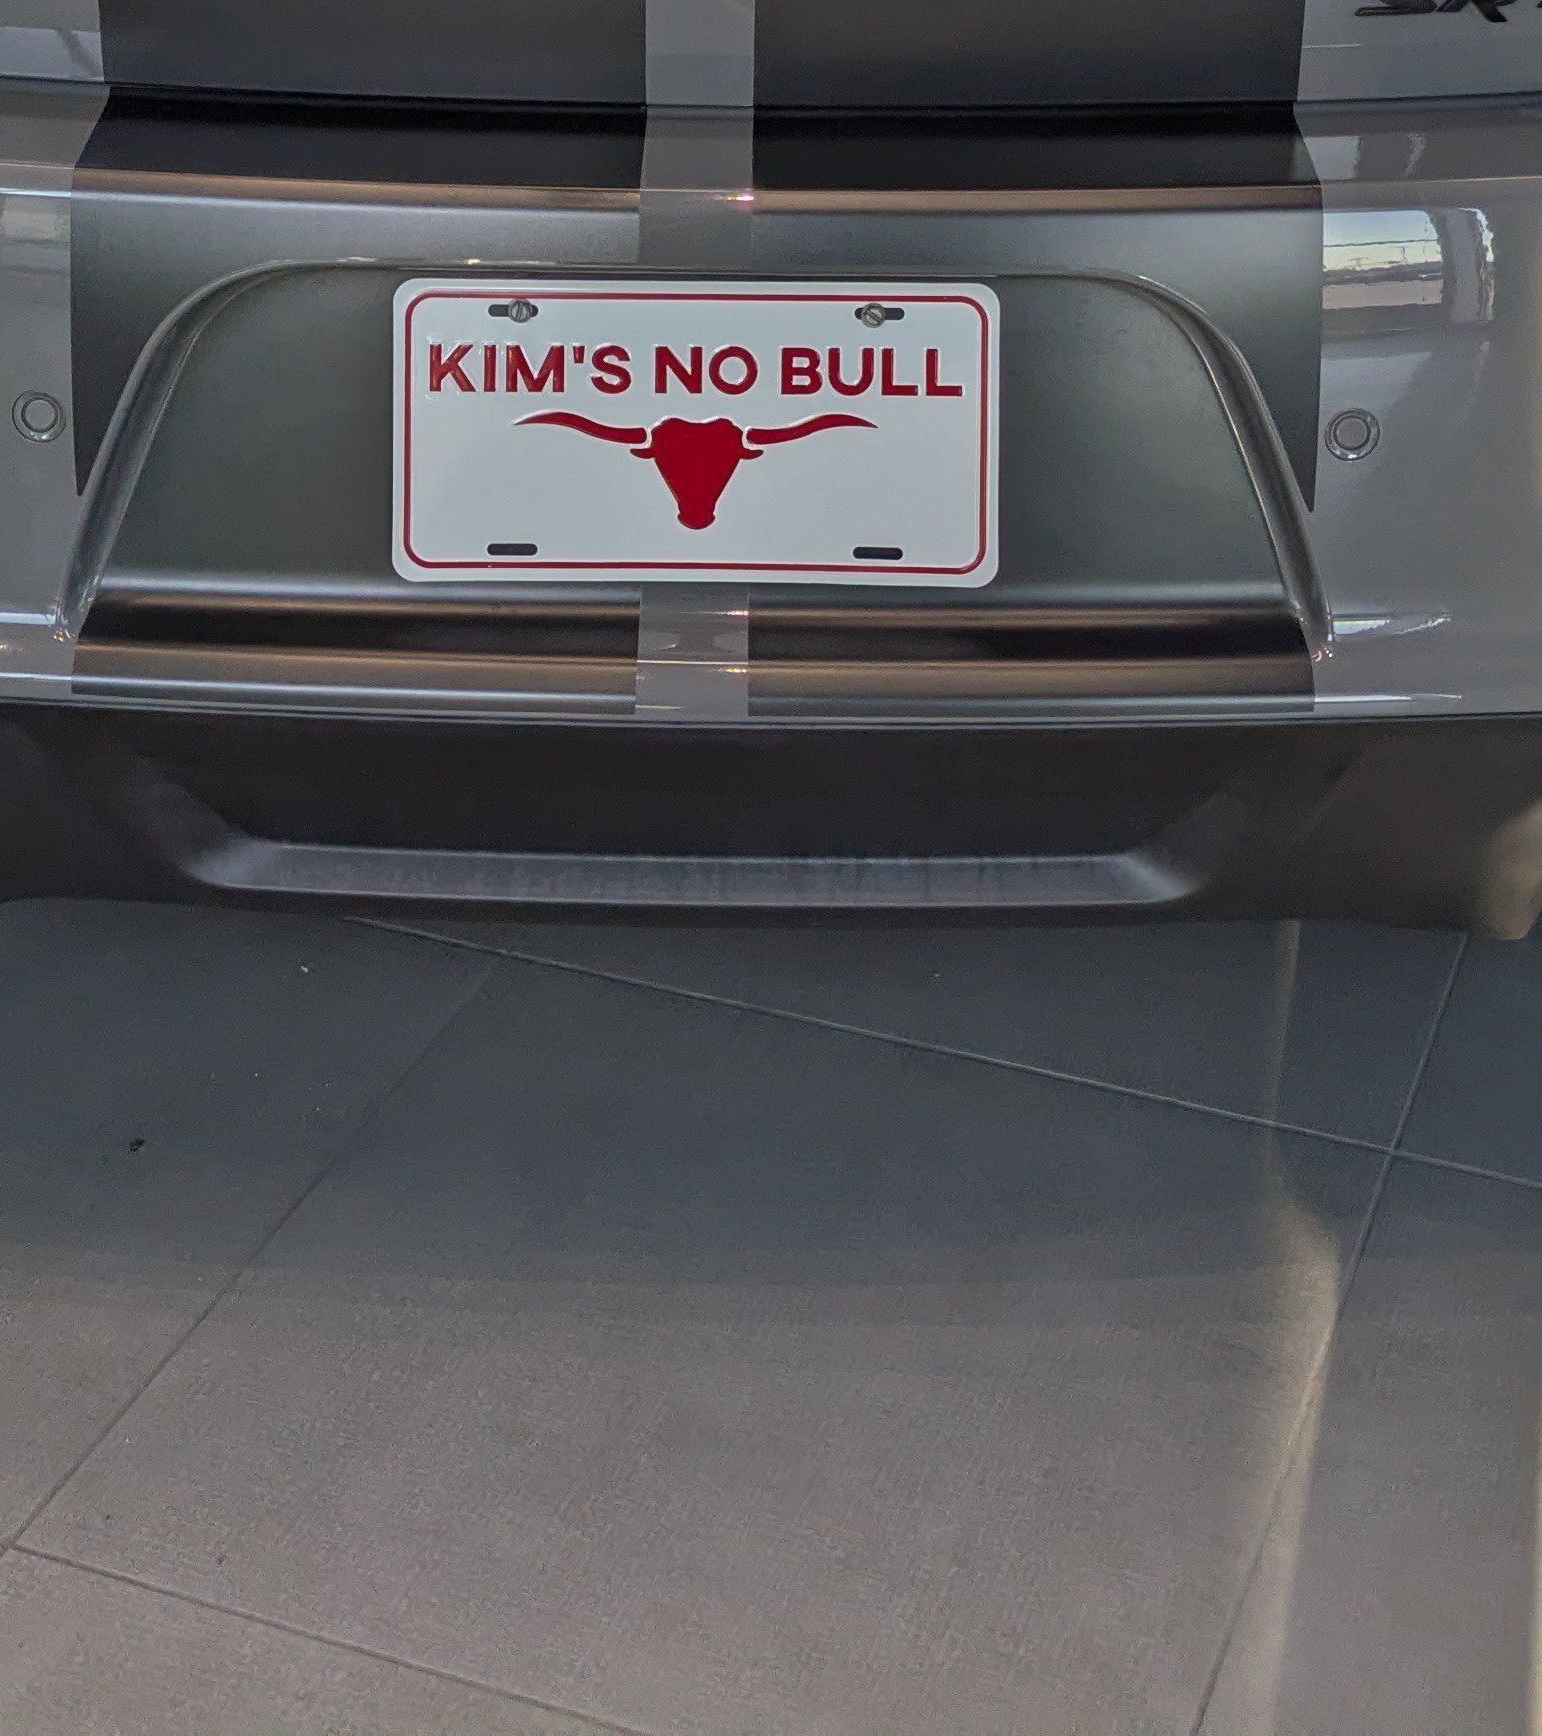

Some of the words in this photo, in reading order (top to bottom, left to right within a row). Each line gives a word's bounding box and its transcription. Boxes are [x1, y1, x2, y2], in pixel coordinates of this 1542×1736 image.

[429, 343, 633, 395] KIM'S
[654, 345, 759, 396] NO
[780, 346, 965, 397] BULL
